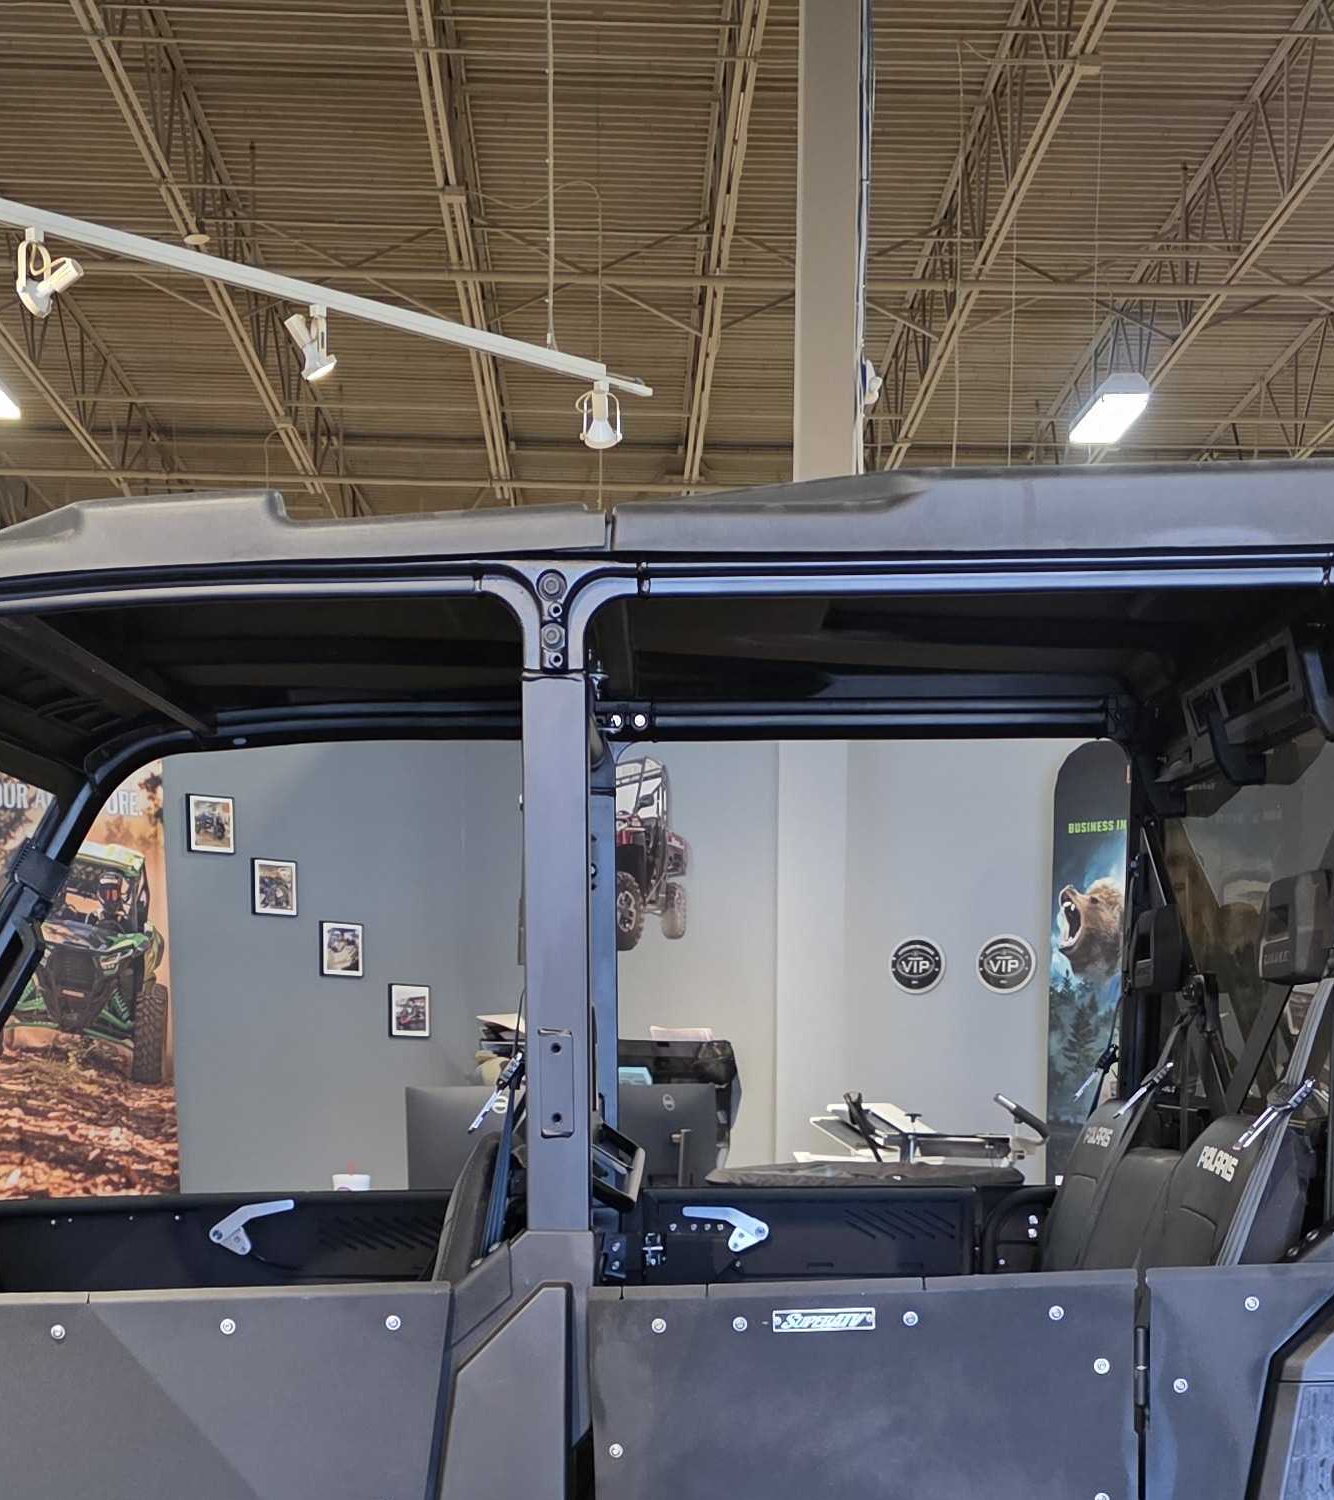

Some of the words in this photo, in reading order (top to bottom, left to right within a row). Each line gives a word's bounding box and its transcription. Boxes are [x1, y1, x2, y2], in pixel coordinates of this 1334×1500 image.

[1068, 821, 1114, 834] BUSINESS
[901, 960, 930, 973] VIP
[989, 959, 1019, 973] VIP
[1083, 1126, 1114, 1148] POLARIS
[1197, 1145, 1239, 1183] POLARIS
